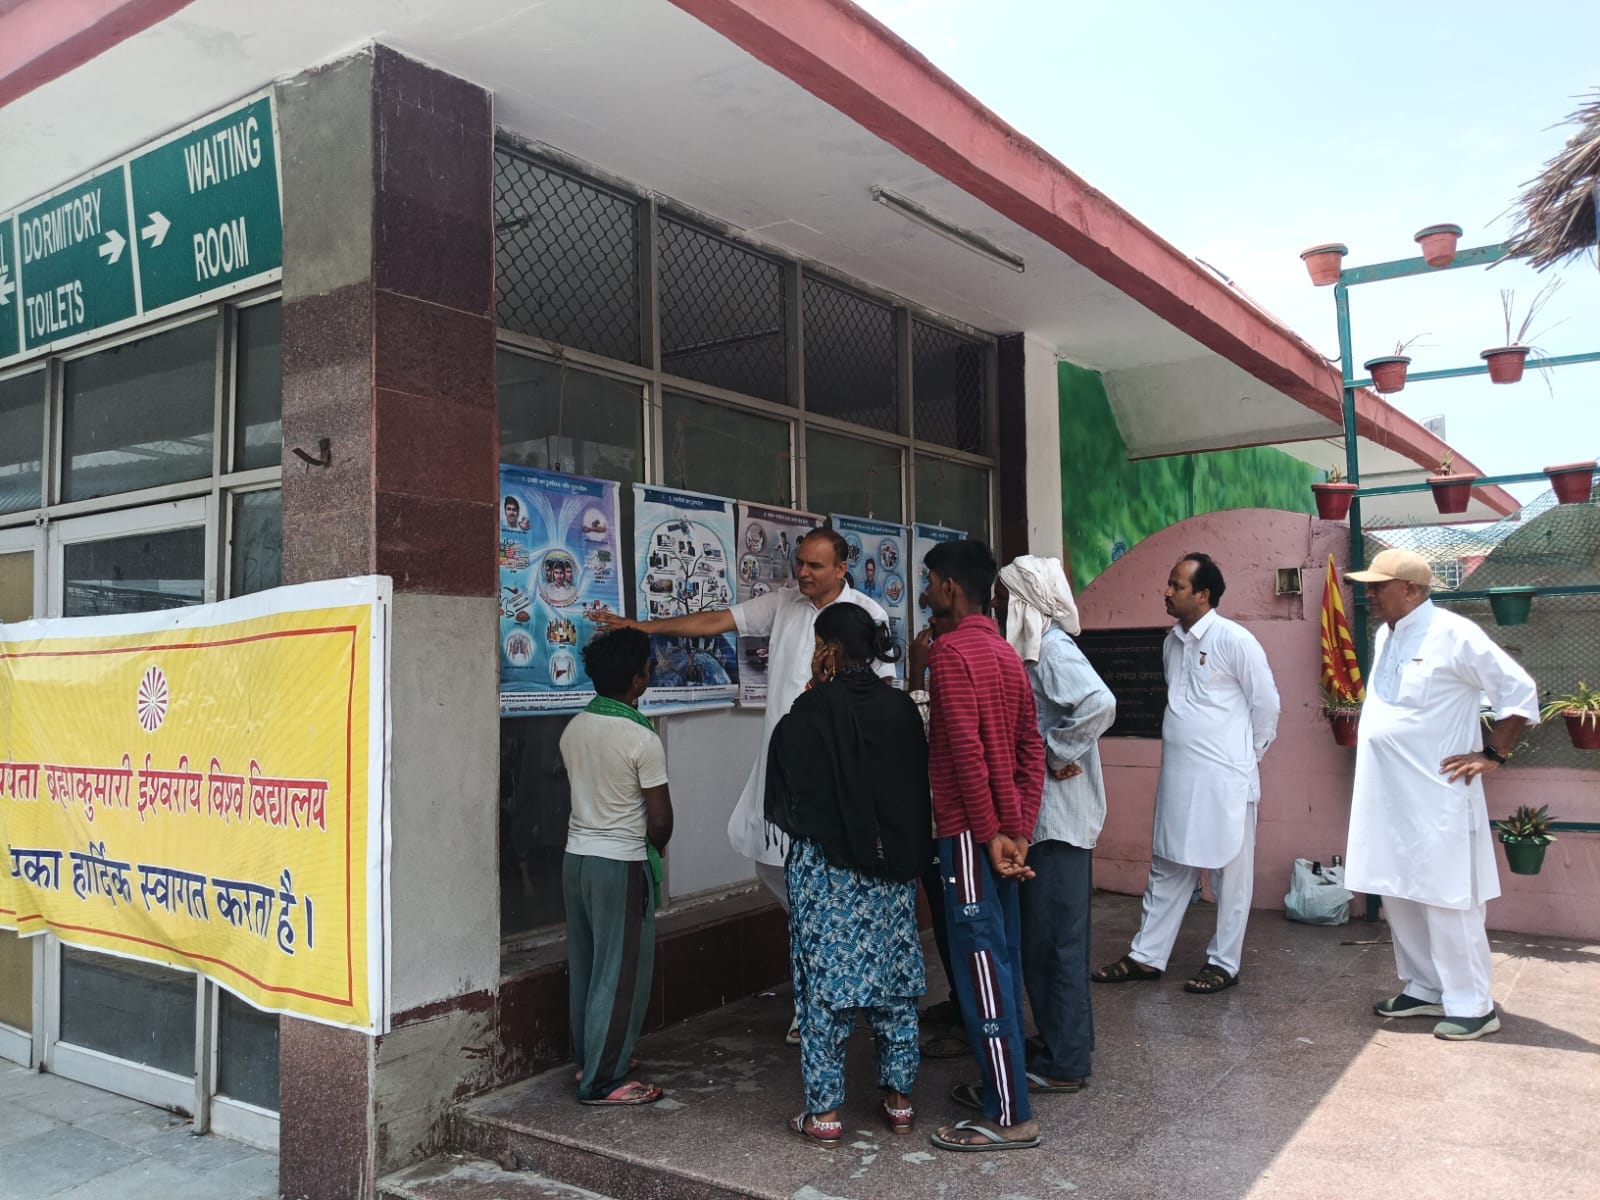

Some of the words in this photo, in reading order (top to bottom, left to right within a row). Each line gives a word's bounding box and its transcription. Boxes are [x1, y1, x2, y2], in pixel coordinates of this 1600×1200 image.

[184, 116, 262, 194] WAITING
[22, 188, 101, 264] DORMITORY
[193, 216, 250, 282] ROOM
[26, 279, 85, 338] TOILETS
[138, 753, 203, 822] ईश्वरीय
[208, 757, 245, 824] विश्व
[249, 759, 328, 831] विद्यालय
[70, 841, 131, 906] हार्दिक
[138, 864, 209, 920] स्वागत
[211, 878, 275, 938] करता
